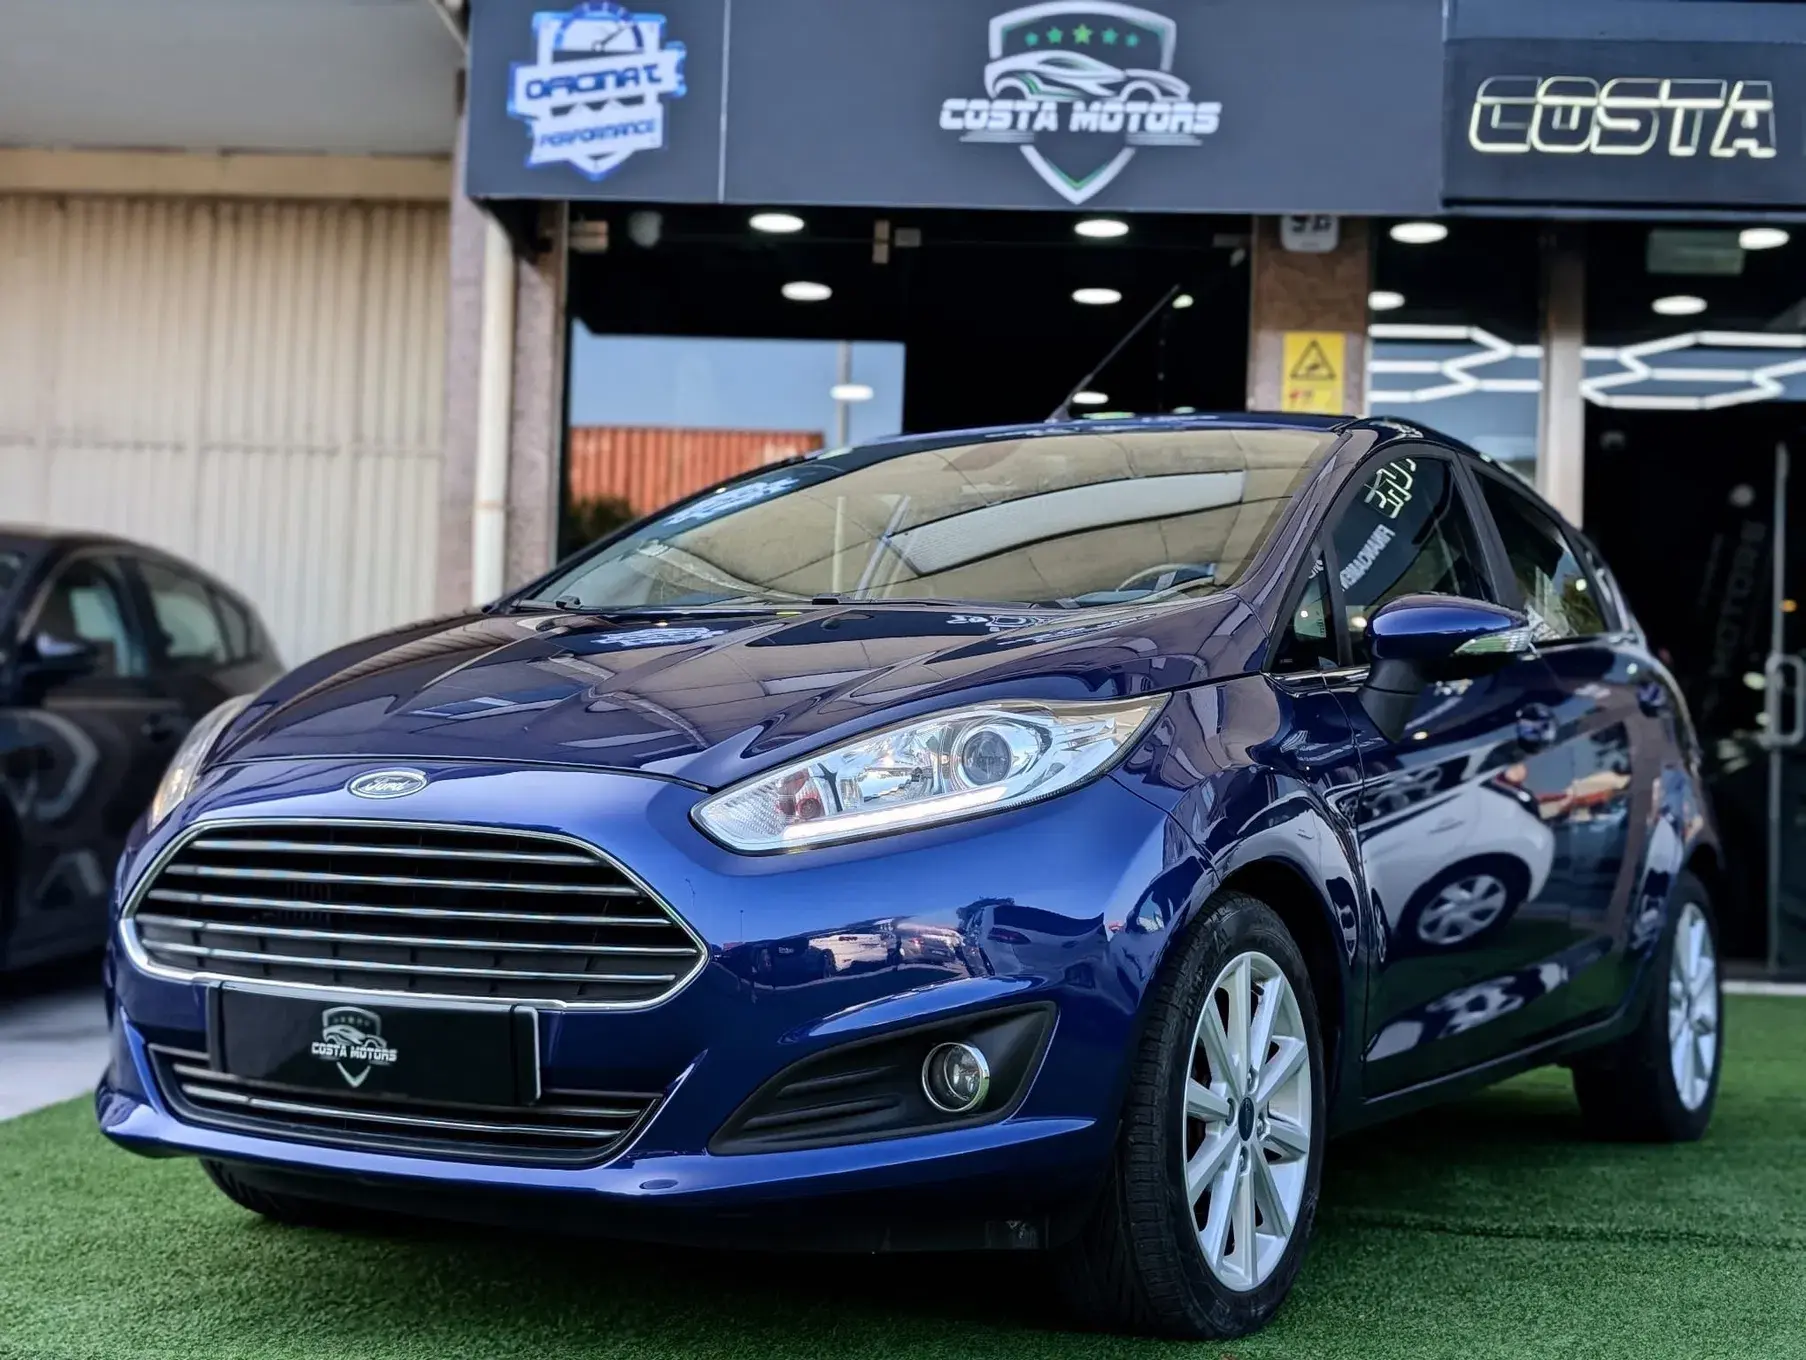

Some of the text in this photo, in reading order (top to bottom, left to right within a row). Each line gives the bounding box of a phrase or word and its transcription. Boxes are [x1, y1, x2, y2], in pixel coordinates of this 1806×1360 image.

[939, 98, 1222, 134] COSTA MOTORS
[1468, 75, 1777, 158] COSTA
[361, 776, 412, 792] Ford
[311, 1041, 398, 1062] COSTA MOTORS
